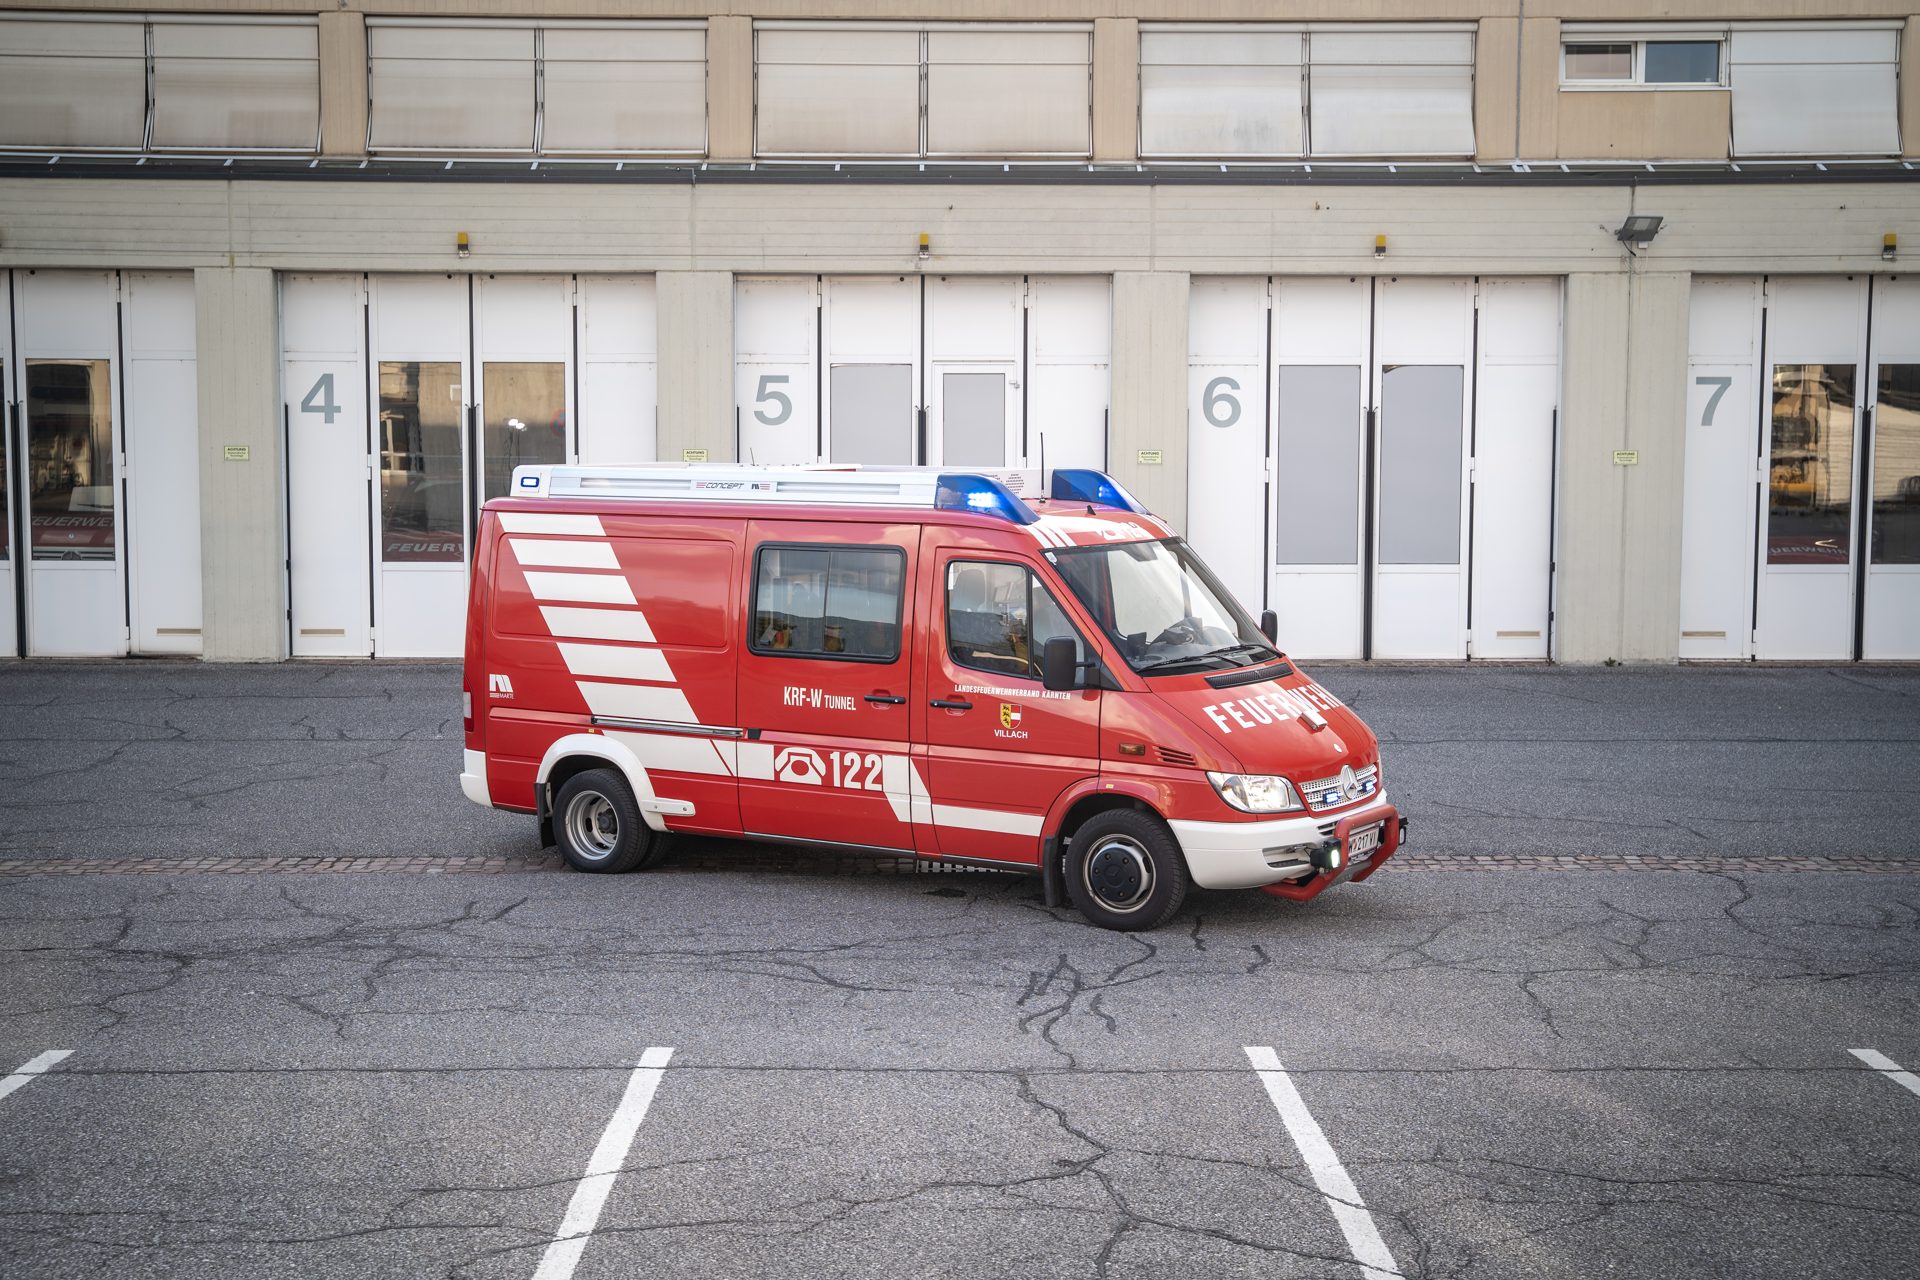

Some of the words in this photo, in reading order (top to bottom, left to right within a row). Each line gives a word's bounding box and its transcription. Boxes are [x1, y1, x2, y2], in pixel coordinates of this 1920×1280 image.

[301, 373, 342, 424] 4
[753, 374, 793, 426] 5
[1202, 376, 1242, 428] 6
[1695, 376, 1732, 426] 7
[705, 482, 744, 490] CONCEPT
[783, 686, 822, 708] KRF-W
[824, 694, 856, 711] TUNNEL
[954, 684, 1040, 698] LANDESFEUERWEHRVERBAND
[1202, 683, 1341, 734] FEUERWEH
[994, 729, 1028, 739] VILLACH
[829, 751, 883, 792] 122
